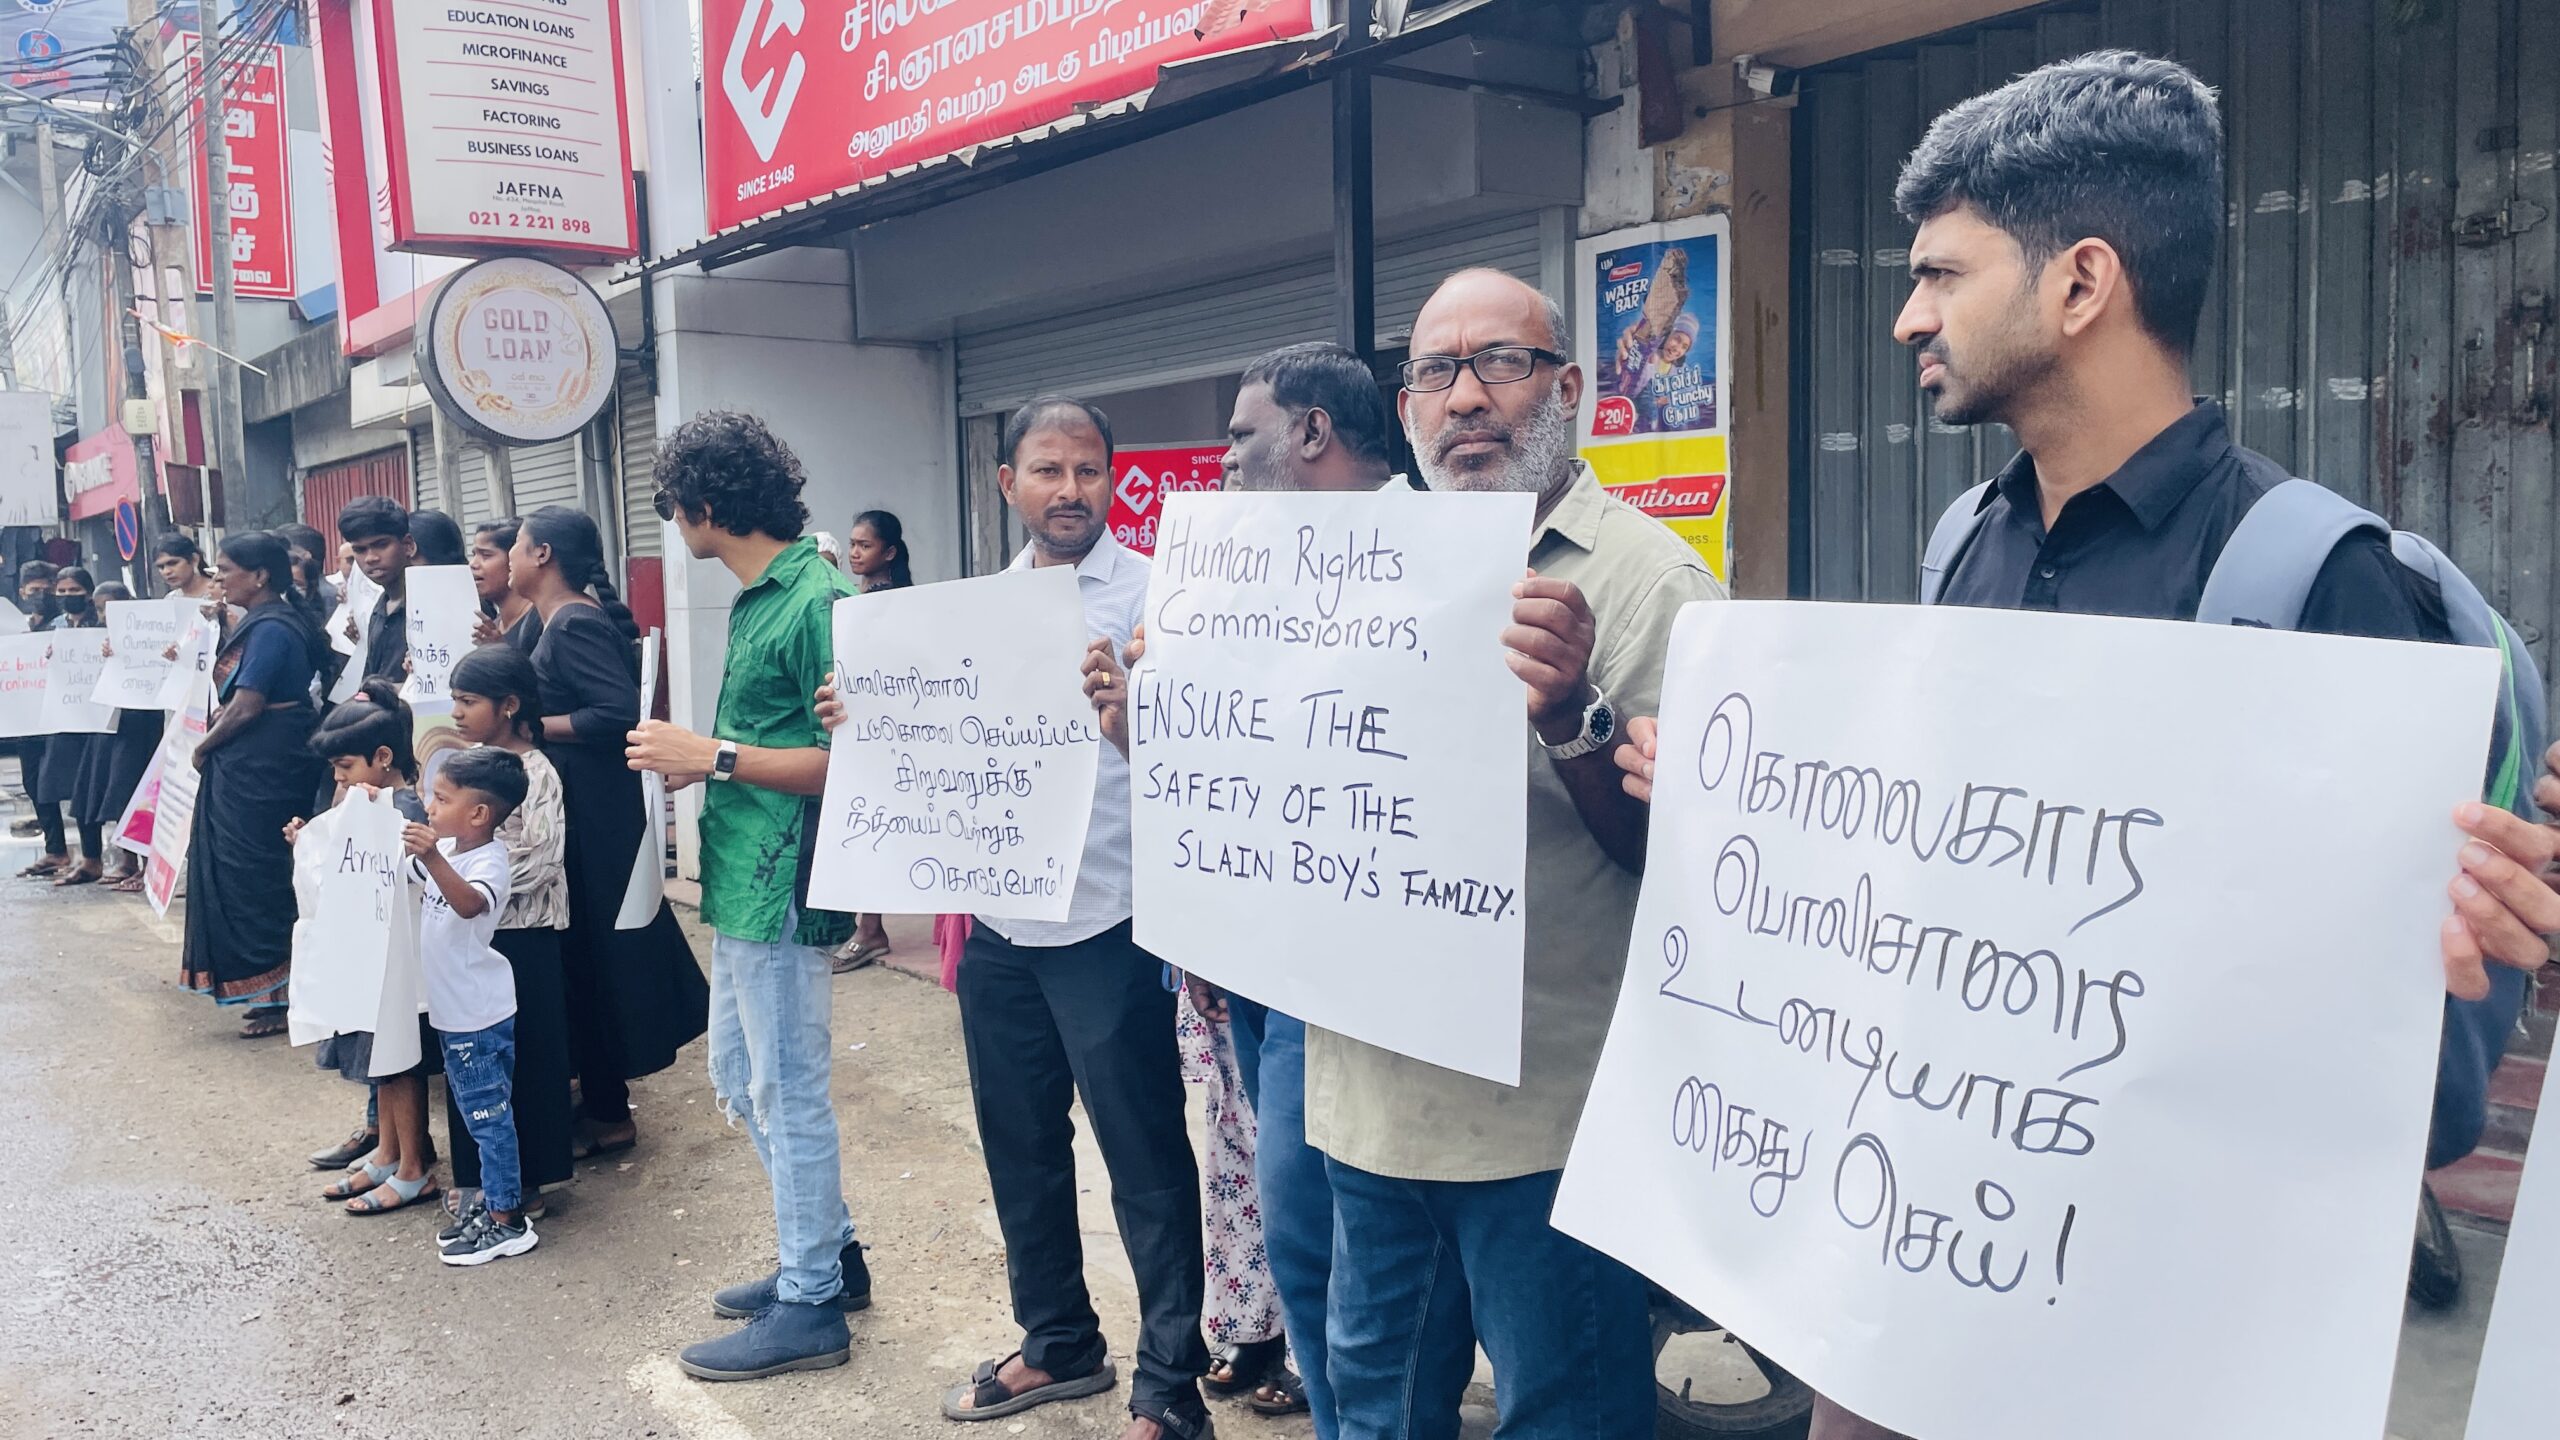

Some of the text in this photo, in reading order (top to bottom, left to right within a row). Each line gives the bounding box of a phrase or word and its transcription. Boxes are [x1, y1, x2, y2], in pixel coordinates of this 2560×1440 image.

[447, 9, 575, 39] EDUCATION LOANS
[462, 43, 568, 69] MICROFINANCE
[491, 78, 550, 96] SAVINGS
[848, 1, 1212, 159] அனுமதி பெற்ற அடகு பிடிப்பவ
[483, 109, 561, 130] FACTORING
[468, 141, 579, 164] BUSINESS LOANS
[496, 181, 563, 200] JAFFNA
[737, 164, 795, 201] SINCE 1948
[469, 211, 591, 234] 021 2 221 898
[1605, 278, 1649, 304] WAFER
[1615, 294, 1640, 314] BAR
[483, 307, 550, 333] GOLD
[485, 337, 551, 361] LOAN
[1671, 385, 1713, 406] Funchy
[1191, 454, 1222, 465] SINCE
[1164, 518, 1404, 620] Human Rights
[1158, 588, 1429, 661] Commissioners,
[1136, 669, 1409, 760] ENSURE THE
[1143, 763, 1418, 839] SAFETY OF THE
[1698, 692, 2165, 936] கொலைகார
[1174, 829, 1274, 883] SLAIN
[1400, 869, 1517, 920] FAMILY.
[1658, 925, 2101, 1157] உடனடியாக
[1673, 1075, 2078, 1306] கைது செய்!
